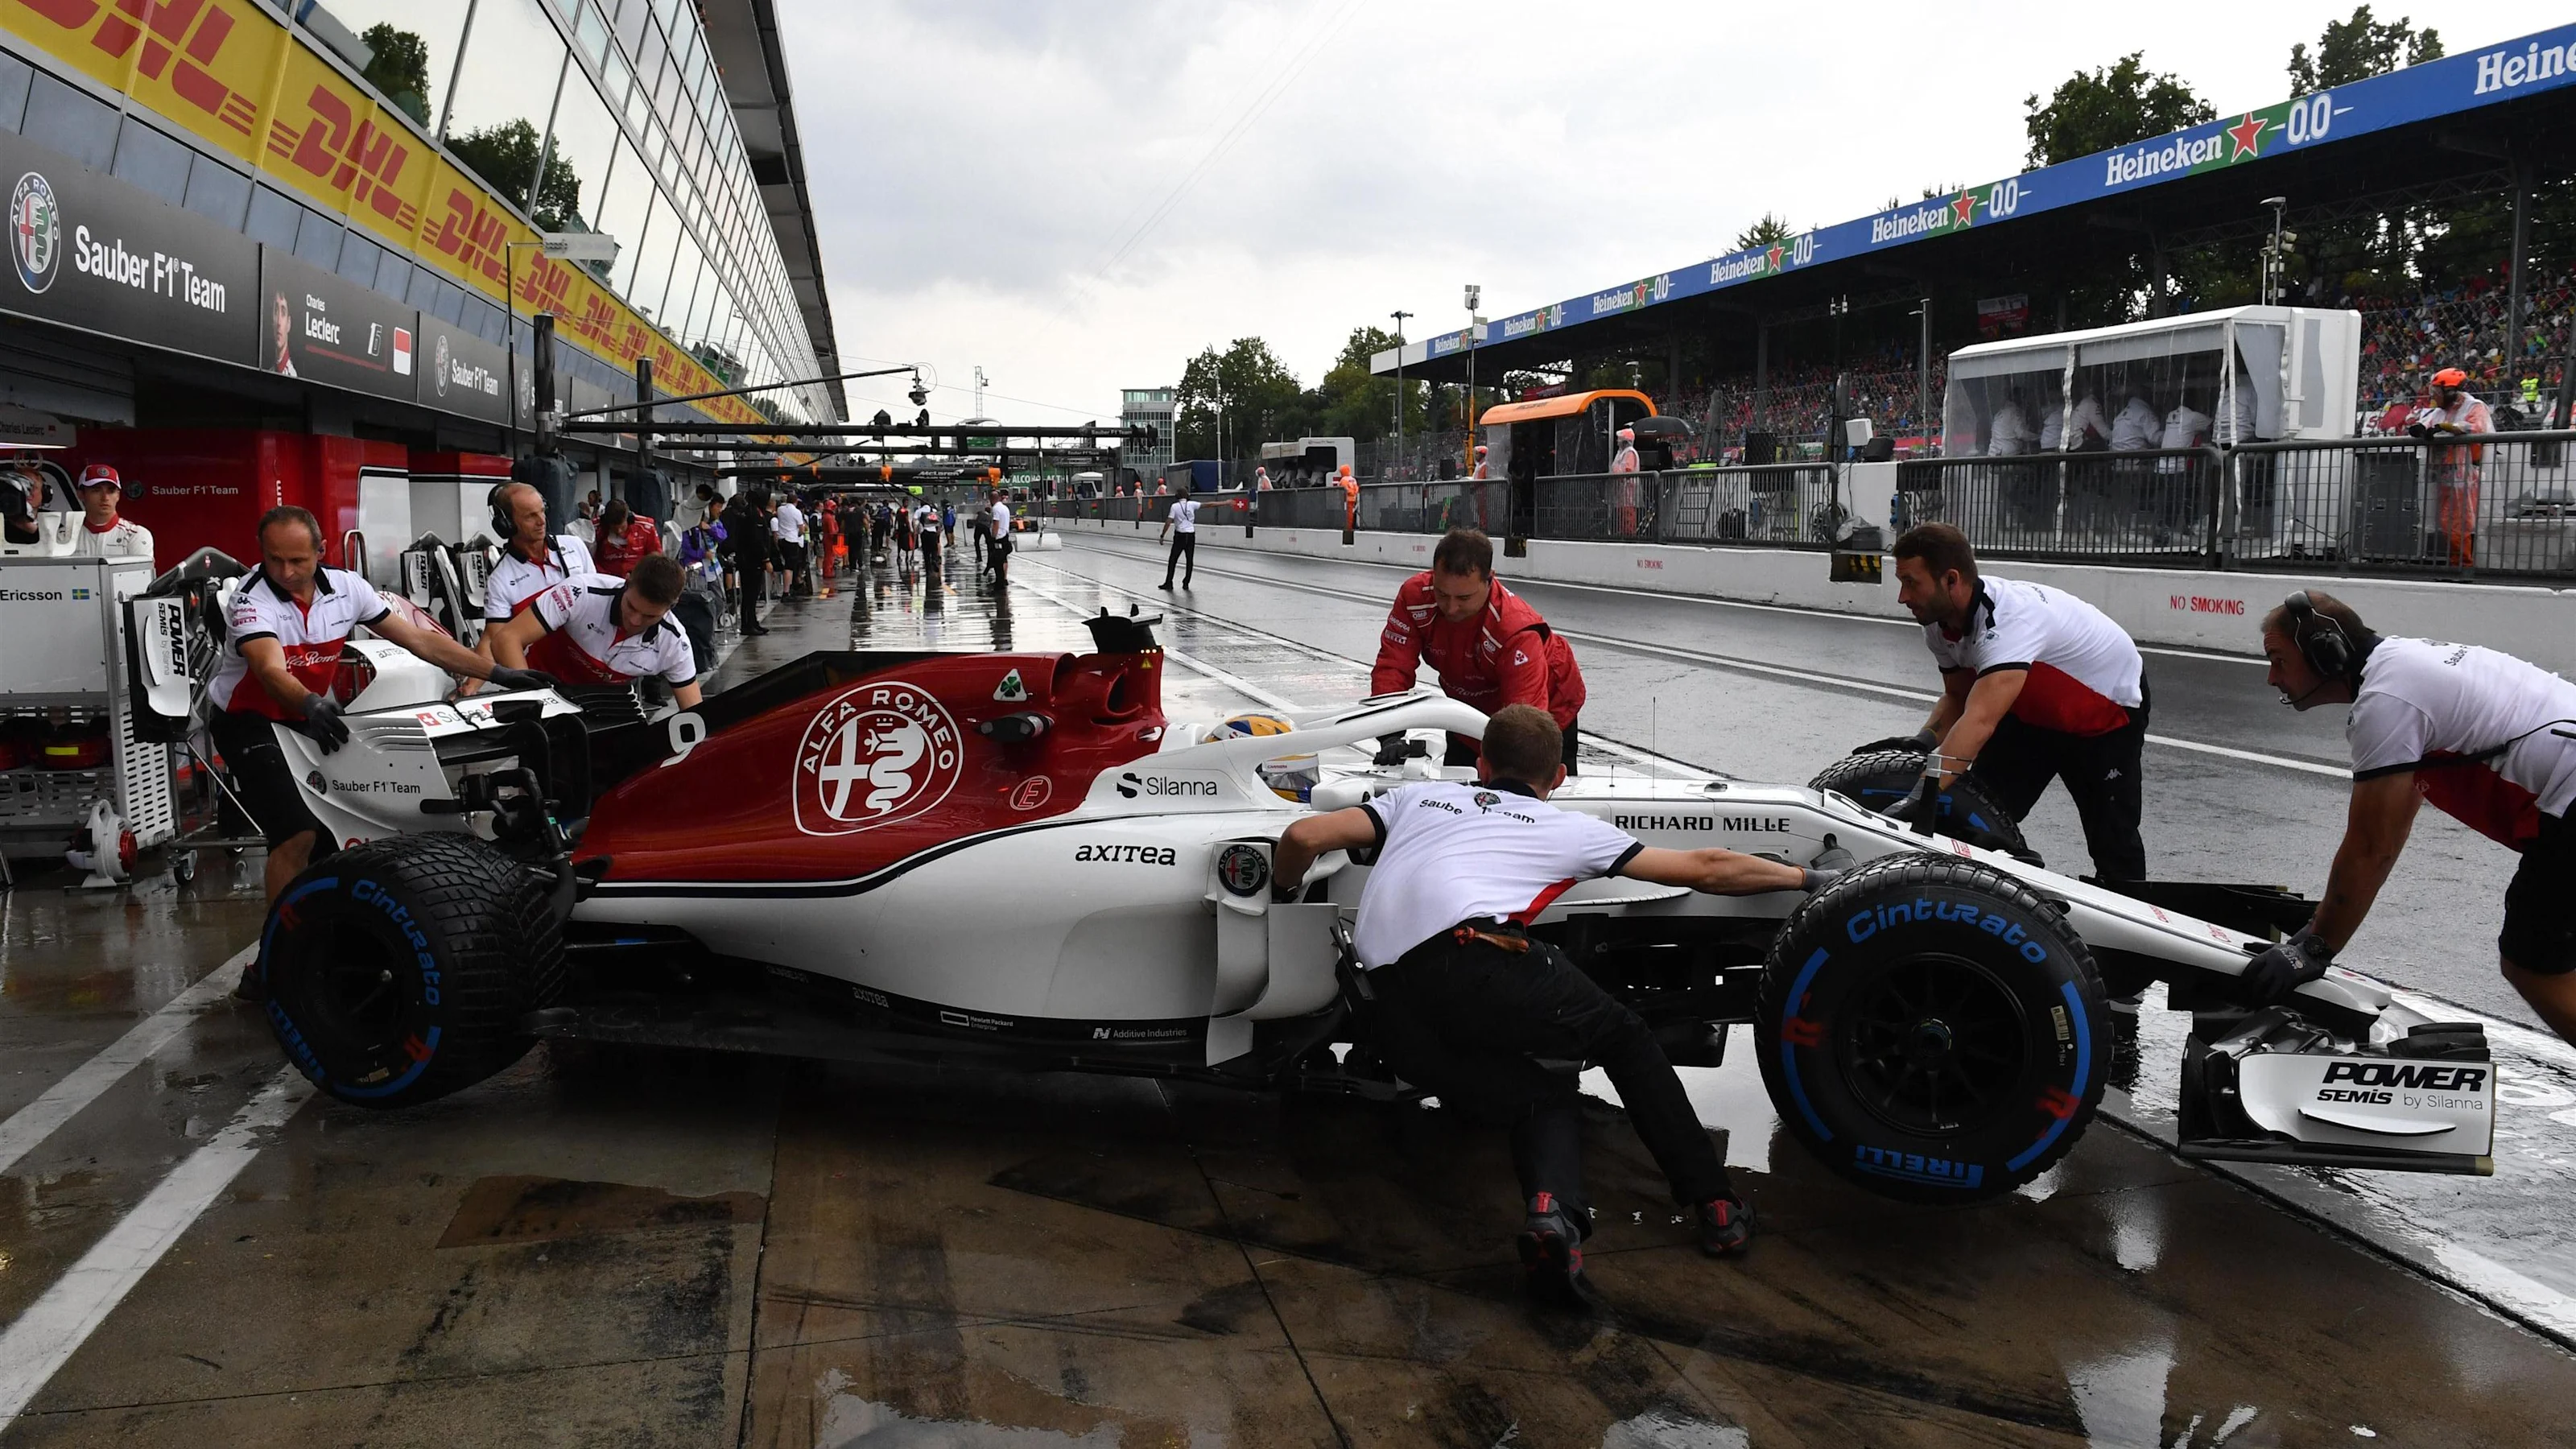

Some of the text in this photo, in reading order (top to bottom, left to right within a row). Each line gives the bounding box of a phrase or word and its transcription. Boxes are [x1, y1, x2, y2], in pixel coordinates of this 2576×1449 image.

[291, 84, 408, 221] DHL
[2105, 93, 2332, 188] Heineken 0.0
[11, 178, 59, 242] ALFA ROMEO
[1871, 179, 2018, 245] Heineken 0.0
[436, 188, 507, 281] DHL
[75, 225, 150, 290] Sauber
[181, 261, 225, 313] Team
[1710, 234, 1813, 285] Heineken 0.0
[306, 293, 325, 312] Charles
[523, 250, 572, 323] DHL
[1592, 274, 1669, 315] Heineken 0.0
[305, 312, 341, 345] Leclerc
[580, 293, 616, 349] DHL
[1505, 304, 1562, 337] Heineken 0.0
[1435, 336, 1460, 354] Heineken
[452, 358, 475, 389] Sauber
[484, 369, 498, 396] Team
[23, 423, 44, 436] Leclerc
[152, 485, 191, 495] Sauber
[210, 485, 239, 495] Team
[420, 555, 428, 589] POWER
[476, 555, 485, 588] POWER
[0, 589, 62, 601] Ericsson
[2170, 595, 2244, 616] NO SMOKING
[1411, 610, 1429, 621] OMP
[167, 604, 186, 677] POWER
[660, 712, 706, 768] 9
[803, 689, 955, 774] ALFA ROMEO
[332, 780, 370, 792] Sauber
[390, 782, 421, 795] Team
[1146, 776, 1217, 795] Silanna
[1615, 815, 1790, 832] RICHARD MILLE
[1219, 848, 1235, 869] ALFA
[351, 879, 441, 1006] Cinturato
[1846, 898, 2047, 964] Cinturato
[970, 1015, 1013, 1027] Hewlett Packard
[971, 1023, 998, 1031] Enterprise
[1113, 1027, 1187, 1038] Additive Industries
[2322, 1061, 2487, 1093] POWER
[2404, 1093, 2421, 1109] by
[2427, 1095, 2483, 1110] Silanna
[1856, 1145, 1984, 1188] PIRELLI
